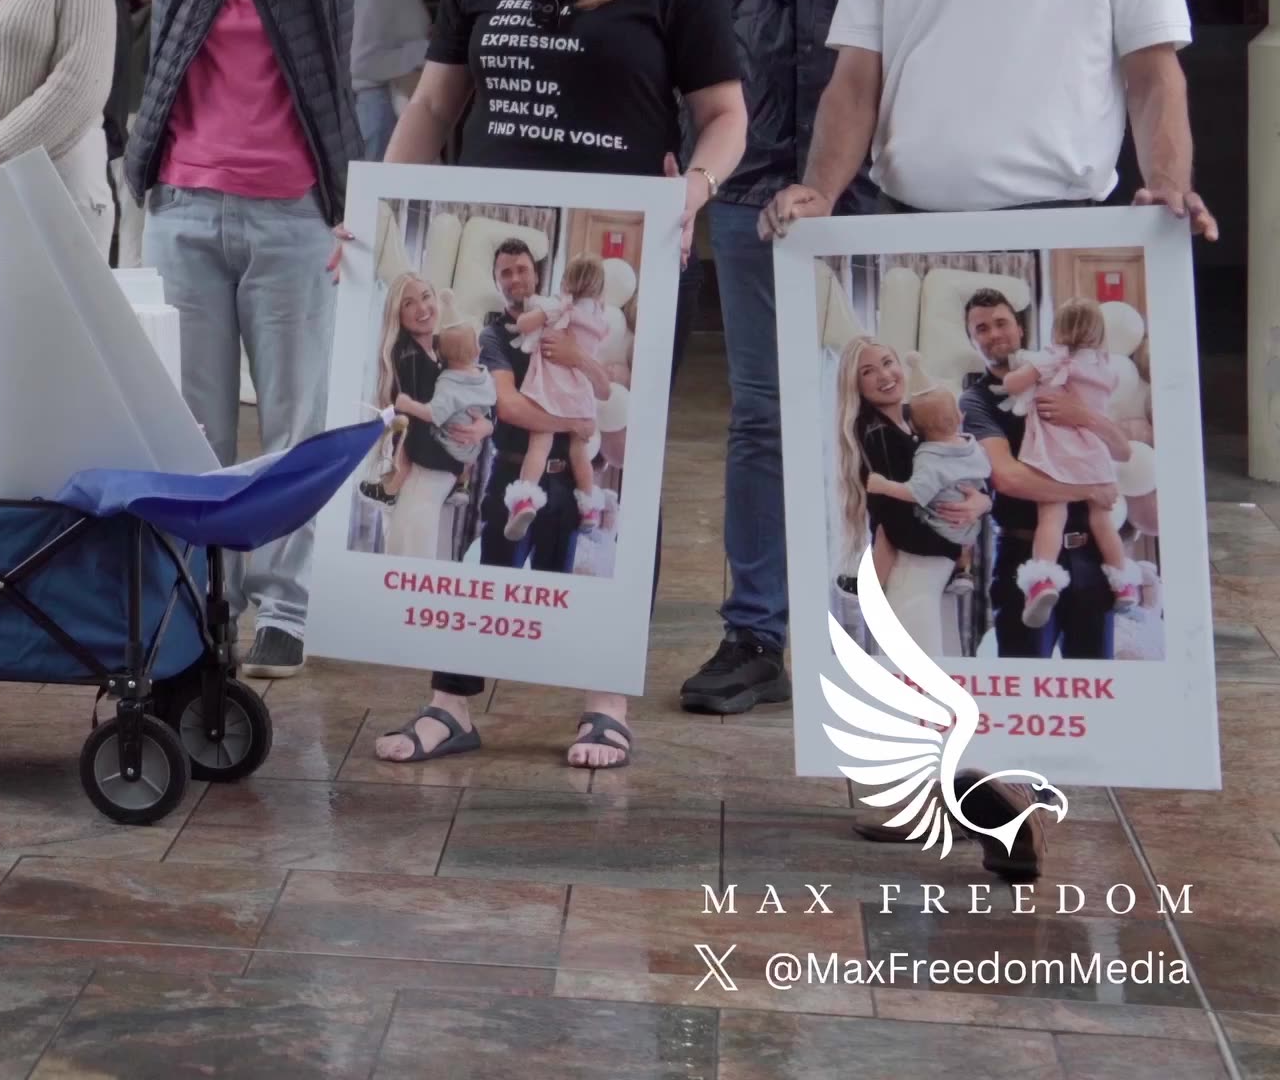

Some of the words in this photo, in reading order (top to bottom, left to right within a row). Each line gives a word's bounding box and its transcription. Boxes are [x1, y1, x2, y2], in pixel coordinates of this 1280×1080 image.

[481, 34, 584, 52] EXPRESSION.
[480, 56, 535, 70] TRUTH.
[486, 77, 531, 92] STAND
[536, 80, 561, 95] UP.
[490, 99, 529, 114] SPEAK
[533, 104, 558, 119] UP.
[488, 121, 515, 135] FIND
[519, 124, 565, 142] YOUR
[570, 131, 628, 150] VOICE.
[384, 570, 495, 600] CHARLIE
[504, 583, 570, 609] KIRK
[404, 606, 543, 640] 1993-2025
[1034, 676, 1115, 699] KIRK
